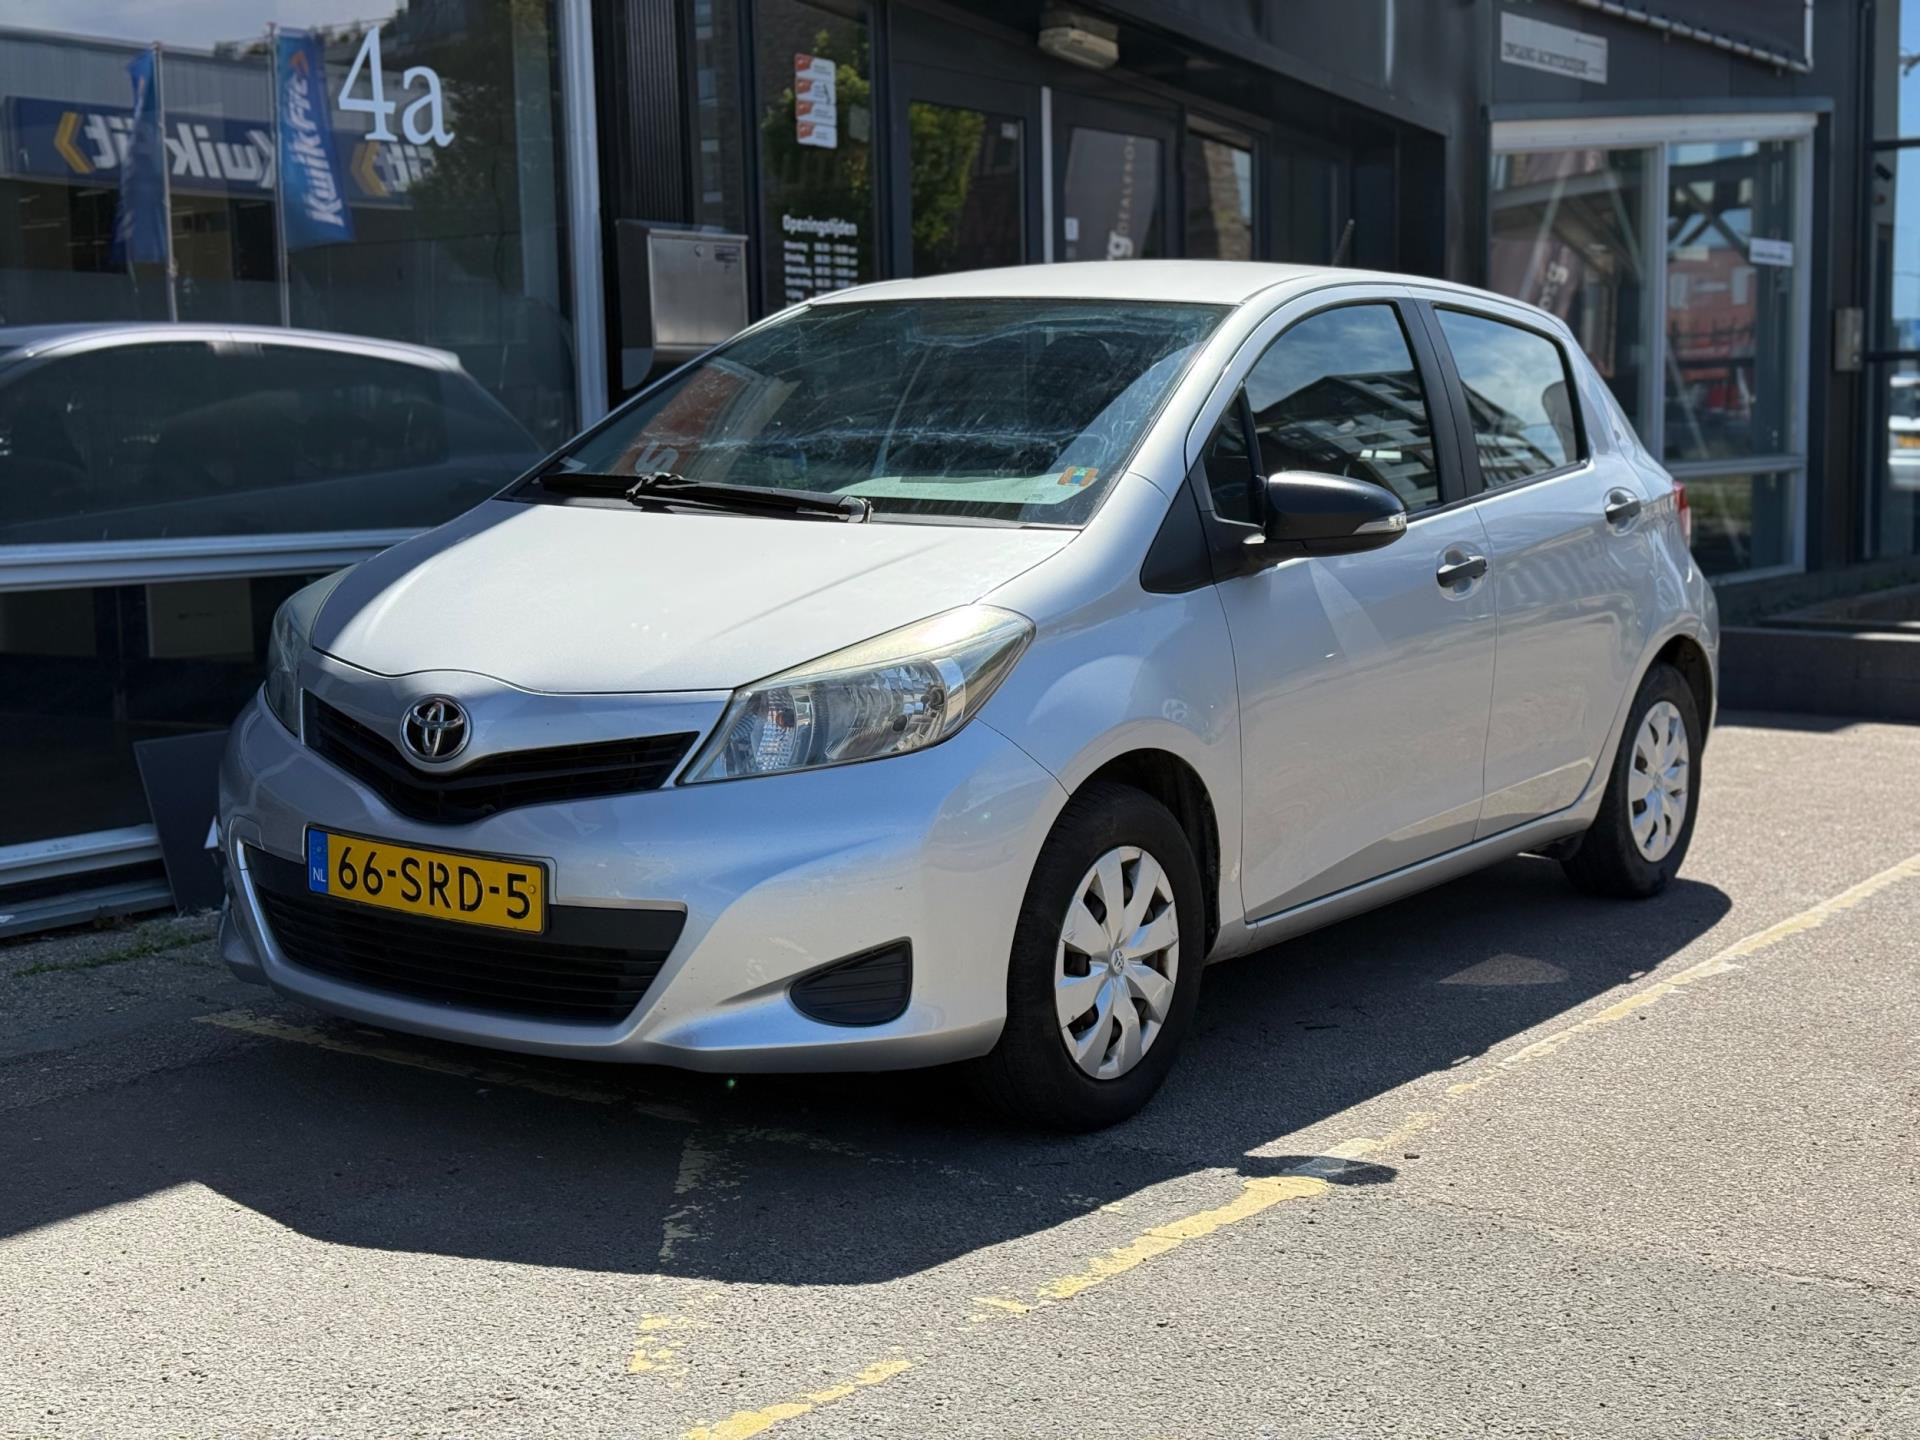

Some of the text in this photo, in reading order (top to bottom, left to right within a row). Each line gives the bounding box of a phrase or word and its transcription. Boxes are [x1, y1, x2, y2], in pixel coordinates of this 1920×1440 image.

[338, 26, 455, 148] 4a
[782, 214, 858, 239] Openingstijden
[312, 867, 326, 883] NL
[338, 845, 531, 921] 66-SRD-5
